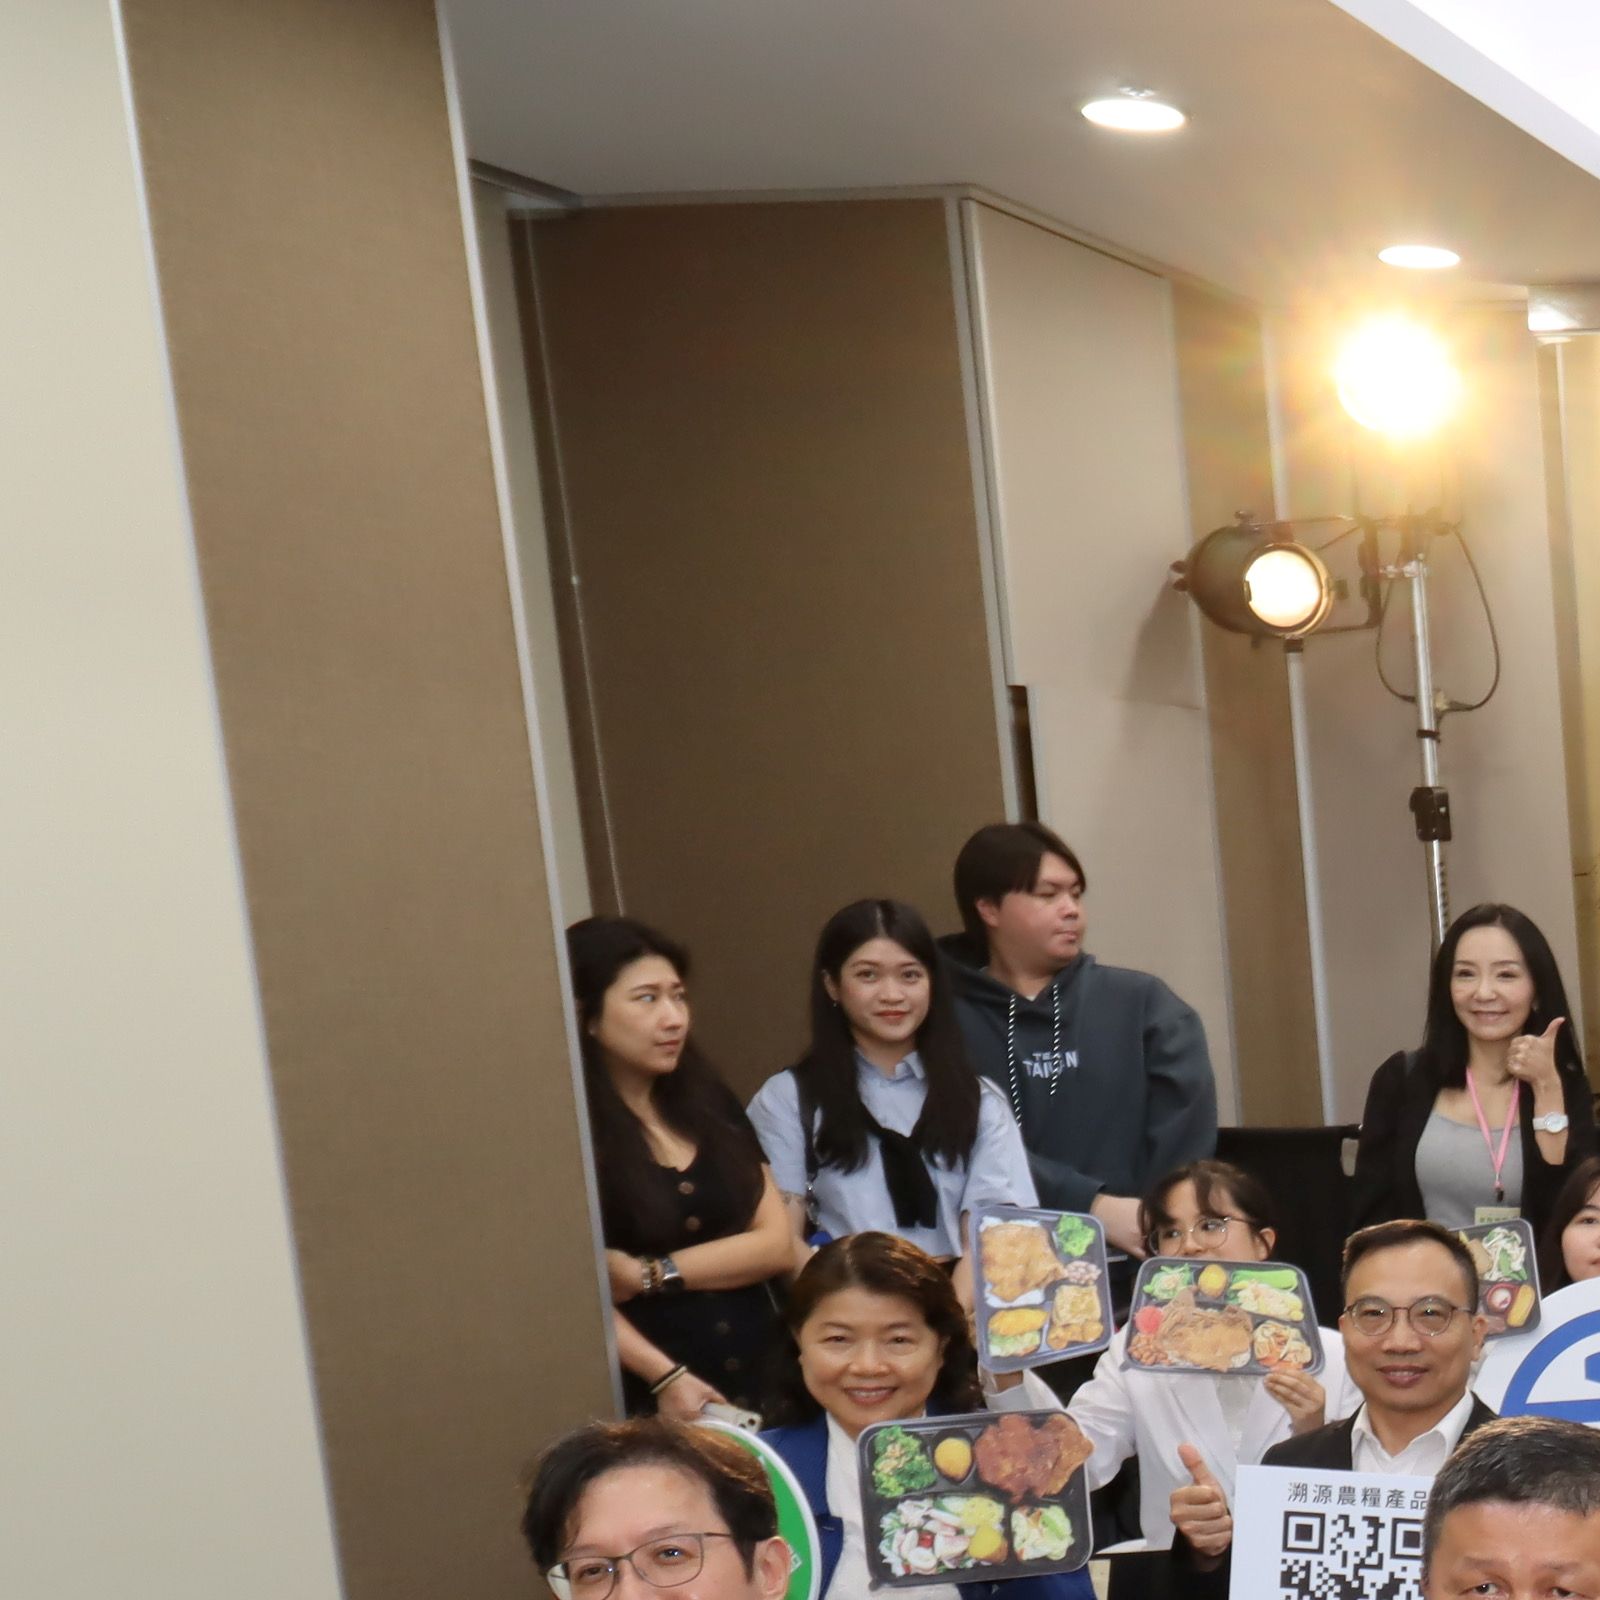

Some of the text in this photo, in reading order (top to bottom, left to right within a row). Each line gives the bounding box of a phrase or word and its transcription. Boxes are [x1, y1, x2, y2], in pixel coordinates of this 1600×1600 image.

[1287, 1482, 1428, 1511] 溯源農糧產品
